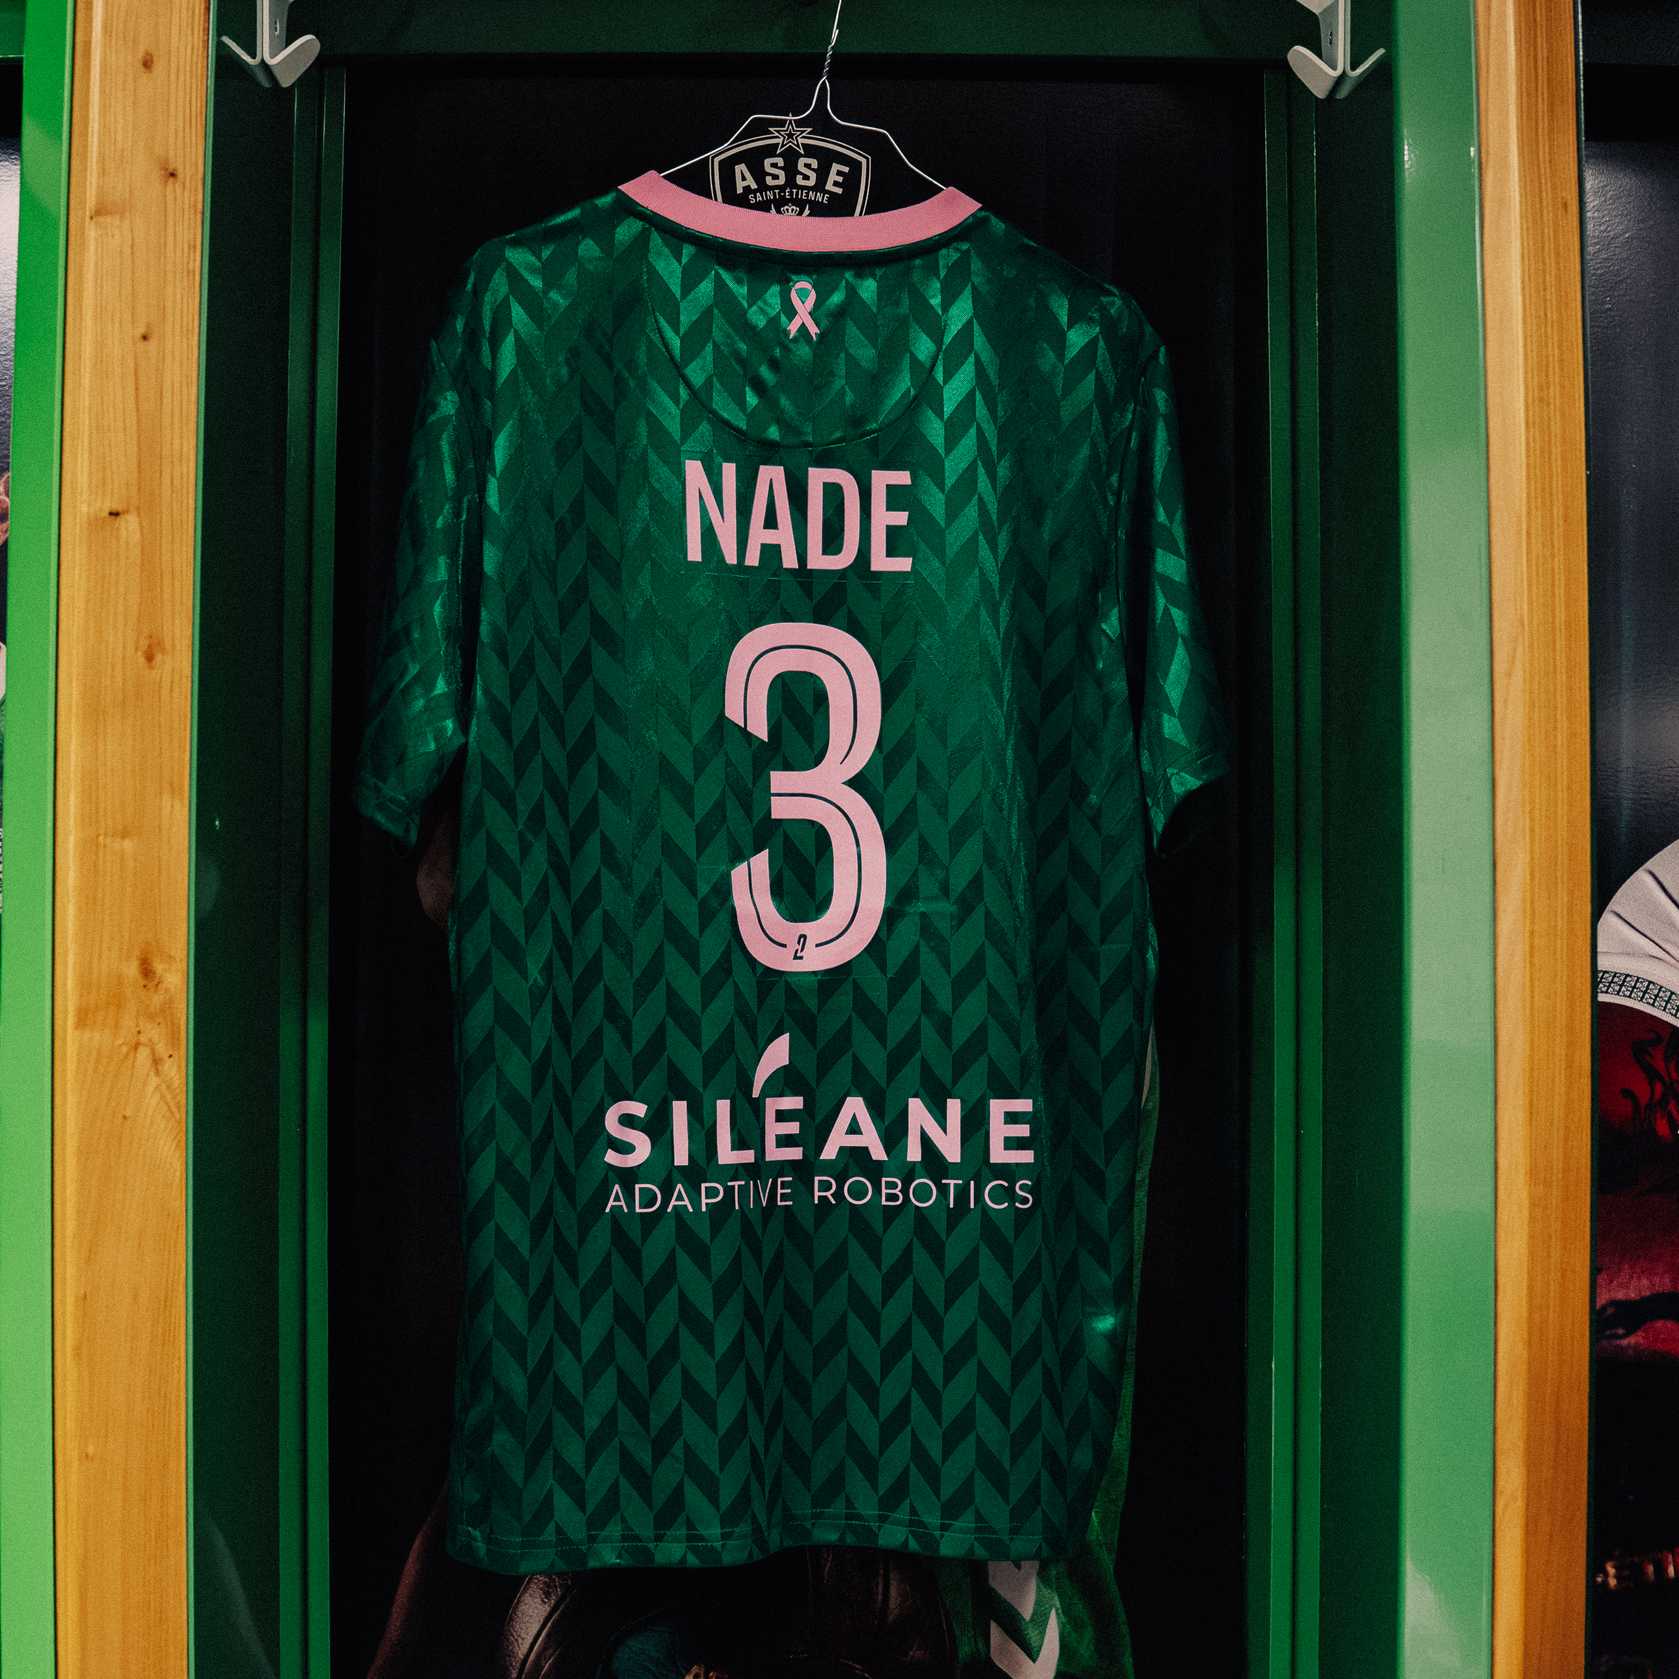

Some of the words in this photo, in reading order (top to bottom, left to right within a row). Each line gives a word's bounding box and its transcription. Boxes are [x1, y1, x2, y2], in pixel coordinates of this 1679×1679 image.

[735, 157, 850, 193] ASSE
[748, 187, 830, 204] SAINT-ÉTIENNE
[685, 460, 913, 572] NADE
[725, 623, 887, 972] 3
[793, 933, 808, 961] 2
[605, 1177, 793, 1213] ADAPTIVE
[814, 1176, 1033, 1210] ROBOTICS
